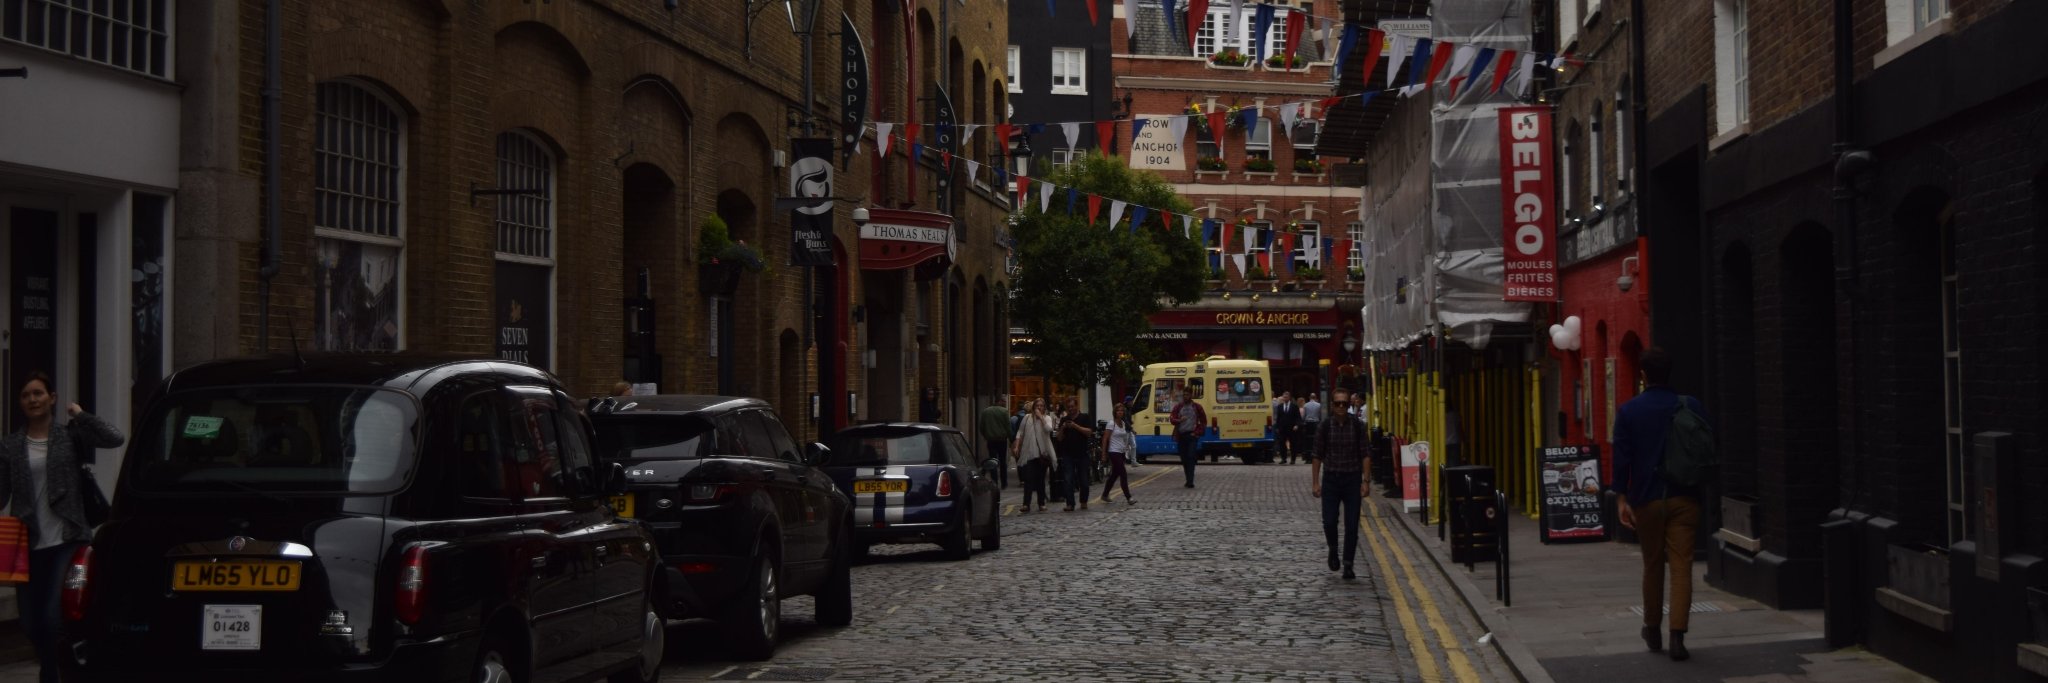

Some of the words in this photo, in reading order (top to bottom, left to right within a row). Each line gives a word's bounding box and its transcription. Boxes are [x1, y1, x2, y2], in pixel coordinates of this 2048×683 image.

[846, 45, 858, 123] SHOPS
[1144, 119, 1169, 128] ROW
[1145, 156, 1170, 165] 1904
[1511, 113, 1544, 255] BELGO
[873, 225, 918, 240] THOMAS
[1507, 260, 1553, 270] MOULES
[1507, 273, 1553, 283] FRITES
[1507, 287, 1554, 297] BIÈRES
[1216, 312, 1254, 325] CROWN
[1256, 310, 1265, 324] &
[1267, 313, 1309, 325] ANCHOR
[502, 327, 528, 345] SEVEN
[1545, 446, 1578, 455] BELGO
[1546, 495, 1598, 507] express
[1573, 513, 1599, 524] 7.50
[184, 565, 242, 586] LM65
[248, 565, 291, 586] YLO
[213, 620, 250, 632] 01428
